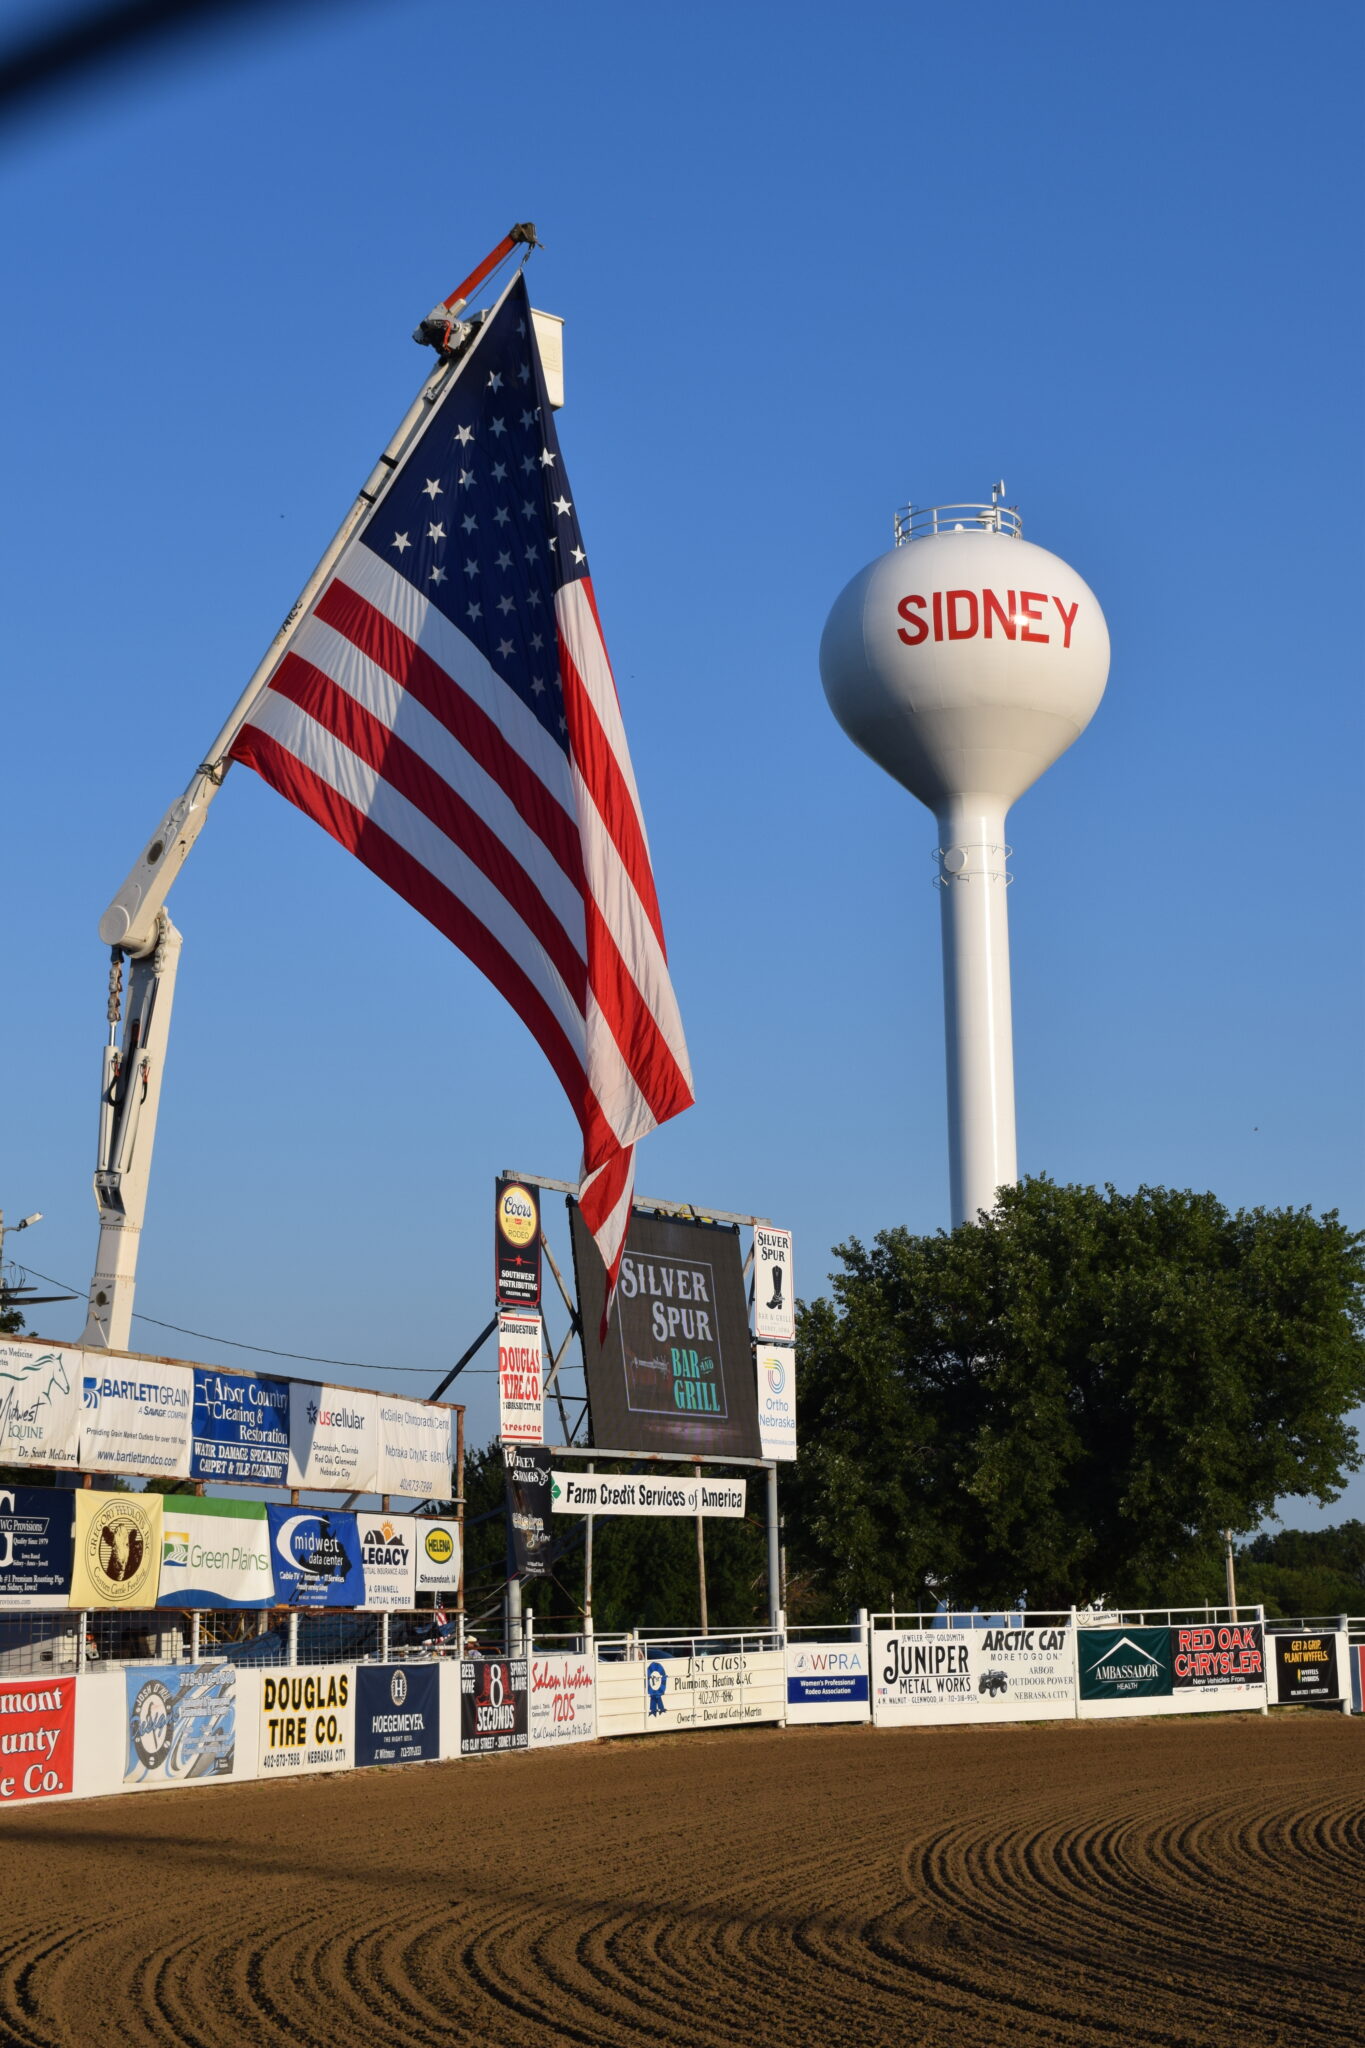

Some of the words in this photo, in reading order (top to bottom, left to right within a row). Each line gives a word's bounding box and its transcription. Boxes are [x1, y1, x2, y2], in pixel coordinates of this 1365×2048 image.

[897, 589, 1079, 649] SIDNEY
[504, 1197, 532, 1218] Coors
[508, 1229, 530, 1240] RODEO
[758, 1232, 788, 1248] SILVER
[761, 1247, 785, 1261] SPUR
[502, 1270, 535, 1281] SOUTHWEST
[621, 1258, 709, 1302] SILVER
[499, 1279, 538, 1290] DISTRIBUTING
[501, 1323, 538, 1335] BRIDGESTONE
[652, 1301, 713, 1341] SPUR
[500, 1346, 540, 1373] DOUGLAS
[671, 1348, 700, 1378] BAR
[701, 1360, 714, 1370] AND
[214, 1378, 244, 1403] Arbor
[249, 1384, 288, 1413] Country
[502, 1374, 524, 1400] TIRE
[525, 1376, 541, 1401] CO.
[674, 1380, 720, 1412] GRILL
[144, 1406, 166, 1417] SAVAGE
[766, 1398, 789, 1411] Ortho
[213, 1401, 255, 1427] Cleaning
[257, 1409, 263, 1424] &
[760, 1415, 795, 1428] Nebraska
[8, 1421, 44, 1440] EQUINE
[124, 1431, 138, 1440] Market
[138, 1433, 154, 1441] Outlets
[240, 1425, 288, 1444] Restoration
[19, 1446, 28, 1457] Dr.
[97, 1450, 178, 1467] www.bartlettandco.com
[195, 1442, 216, 1458] WATER
[219, 1445, 248, 1460] DAMAGE
[250, 1449, 289, 1465] SPECIALISTS
[200, 1458, 227, 1474] CARPET
[228, 1462, 234, 1474] &
[236, 1462, 250, 1476] TILE
[251, 1464, 282, 1478] CLEANING
[315, 1454, 324, 1463] Red
[334, 1456, 357, 1466] Glenwood
[320, 1467, 340, 1476] Nebraska
[341, 1468, 350, 1480] City
[567, 1482, 597, 1504] Farm
[600, 1484, 636, 1505] Credit
[638, 1485, 686, 1506] Services
[688, 1489, 698, 1512] of
[702, 1488, 742, 1508] America
[13, 1520, 42, 1532] Provisions
[90, 1507, 115, 1556] GREGORY
[294, 1531, 340, 1553] midwest
[428, 1539, 451, 1553] HELENA
[191, 1545, 230, 1569] Green
[232, 1552, 269, 1571] Plains
[308, 1553, 322, 1565] data
[323, 1555, 344, 1566] center
[361, 1547, 410, 1566] LEGACY
[280, 1571, 294, 1580] Cable
[377, 1567, 398, 1576] INSURANCE
[4, 1575, 10, 1583] #1
[12, 1574, 32, 1582] Premium
[34, 1575, 54, 1585] Roasting
[54, 1575, 64, 1586] Pigs
[7, 1583, 23, 1593] Sidney,
[24, 1583, 38, 1592] Iowa!
[374, 1584, 399, 1594] GRINNELL
[368, 1596, 390, 1604] MUTUAL
[390, 1596, 411, 1604] MEMBER
[902, 1634, 923, 1644] JEWELER
[936, 1634, 964, 1642] GOLDSMITH
[982, 1630, 1034, 1651] ARCTIC
[1038, 1630, 1066, 1650] CAT
[1179, 1628, 1216, 1652] RED
[1218, 1627, 1256, 1650] OAK
[1292, 1640, 1302, 1651] GET
[1303, 1641, 1308, 1650] A
[811, 1653, 861, 1670] WPRA
[883, 1639, 969, 1685] JUNIPER
[990, 1653, 1015, 1661] MORE
[1018, 1653, 1029, 1661] TO
[1174, 1650, 1262, 1677] CHRYSLER
[1284, 1652, 1302, 1663] PLANT
[462, 1663, 475, 1678] BEER
[686, 1656, 704, 1678] 1st
[712, 1656, 746, 1671] Class
[1028, 1666, 1054, 1674] ARBOR
[1095, 1664, 1159, 1680] AMBASSADOR
[1301, 1668, 1319, 1676] WYFFELS
[532, 1662, 561, 1692] Salon
[562, 1661, 592, 1690] Justin
[712, 1673, 734, 1688] Heating
[824, 1678, 856, 1686] Professional
[1009, 1678, 1046, 1686] OUTDOOR
[1047, 1677, 1074, 1685] POWER
[264, 1674, 348, 1712] DOUGLAS
[394, 1679, 404, 1697] H
[462, 1679, 475, 1694] WINE
[490, 1664, 504, 1708] 8
[900, 1678, 932, 1694] METAL
[936, 1677, 971, 1693] WORKS
[1116, 1682, 1138, 1690] HEALTH
[0, 1686, 63, 1713] mont
[136, 1685, 152, 1706] JOSH
[1014, 1691, 1051, 1700] NEBRASKA
[1052, 1690, 1068, 1699] CITY
[552, 1693, 575, 1723] 1205
[704, 1710, 717, 1721] David
[719, 1711, 728, 1719] and
[744, 1706, 762, 1717] Martin
[372, 1713, 424, 1733] HOEGEMEYER
[477, 1705, 514, 1731] SECONDS
[268, 1717, 306, 1748] TIRE
[315, 1714, 343, 1744] CO.
[1, 1727, 61, 1760] unty
[480, 1737, 494, 1750] STREET
[307, 1750, 333, 1764] NEBRASKA
[335, 1748, 346, 1761] CITY
[23, 1763, 64, 1794] Co.
